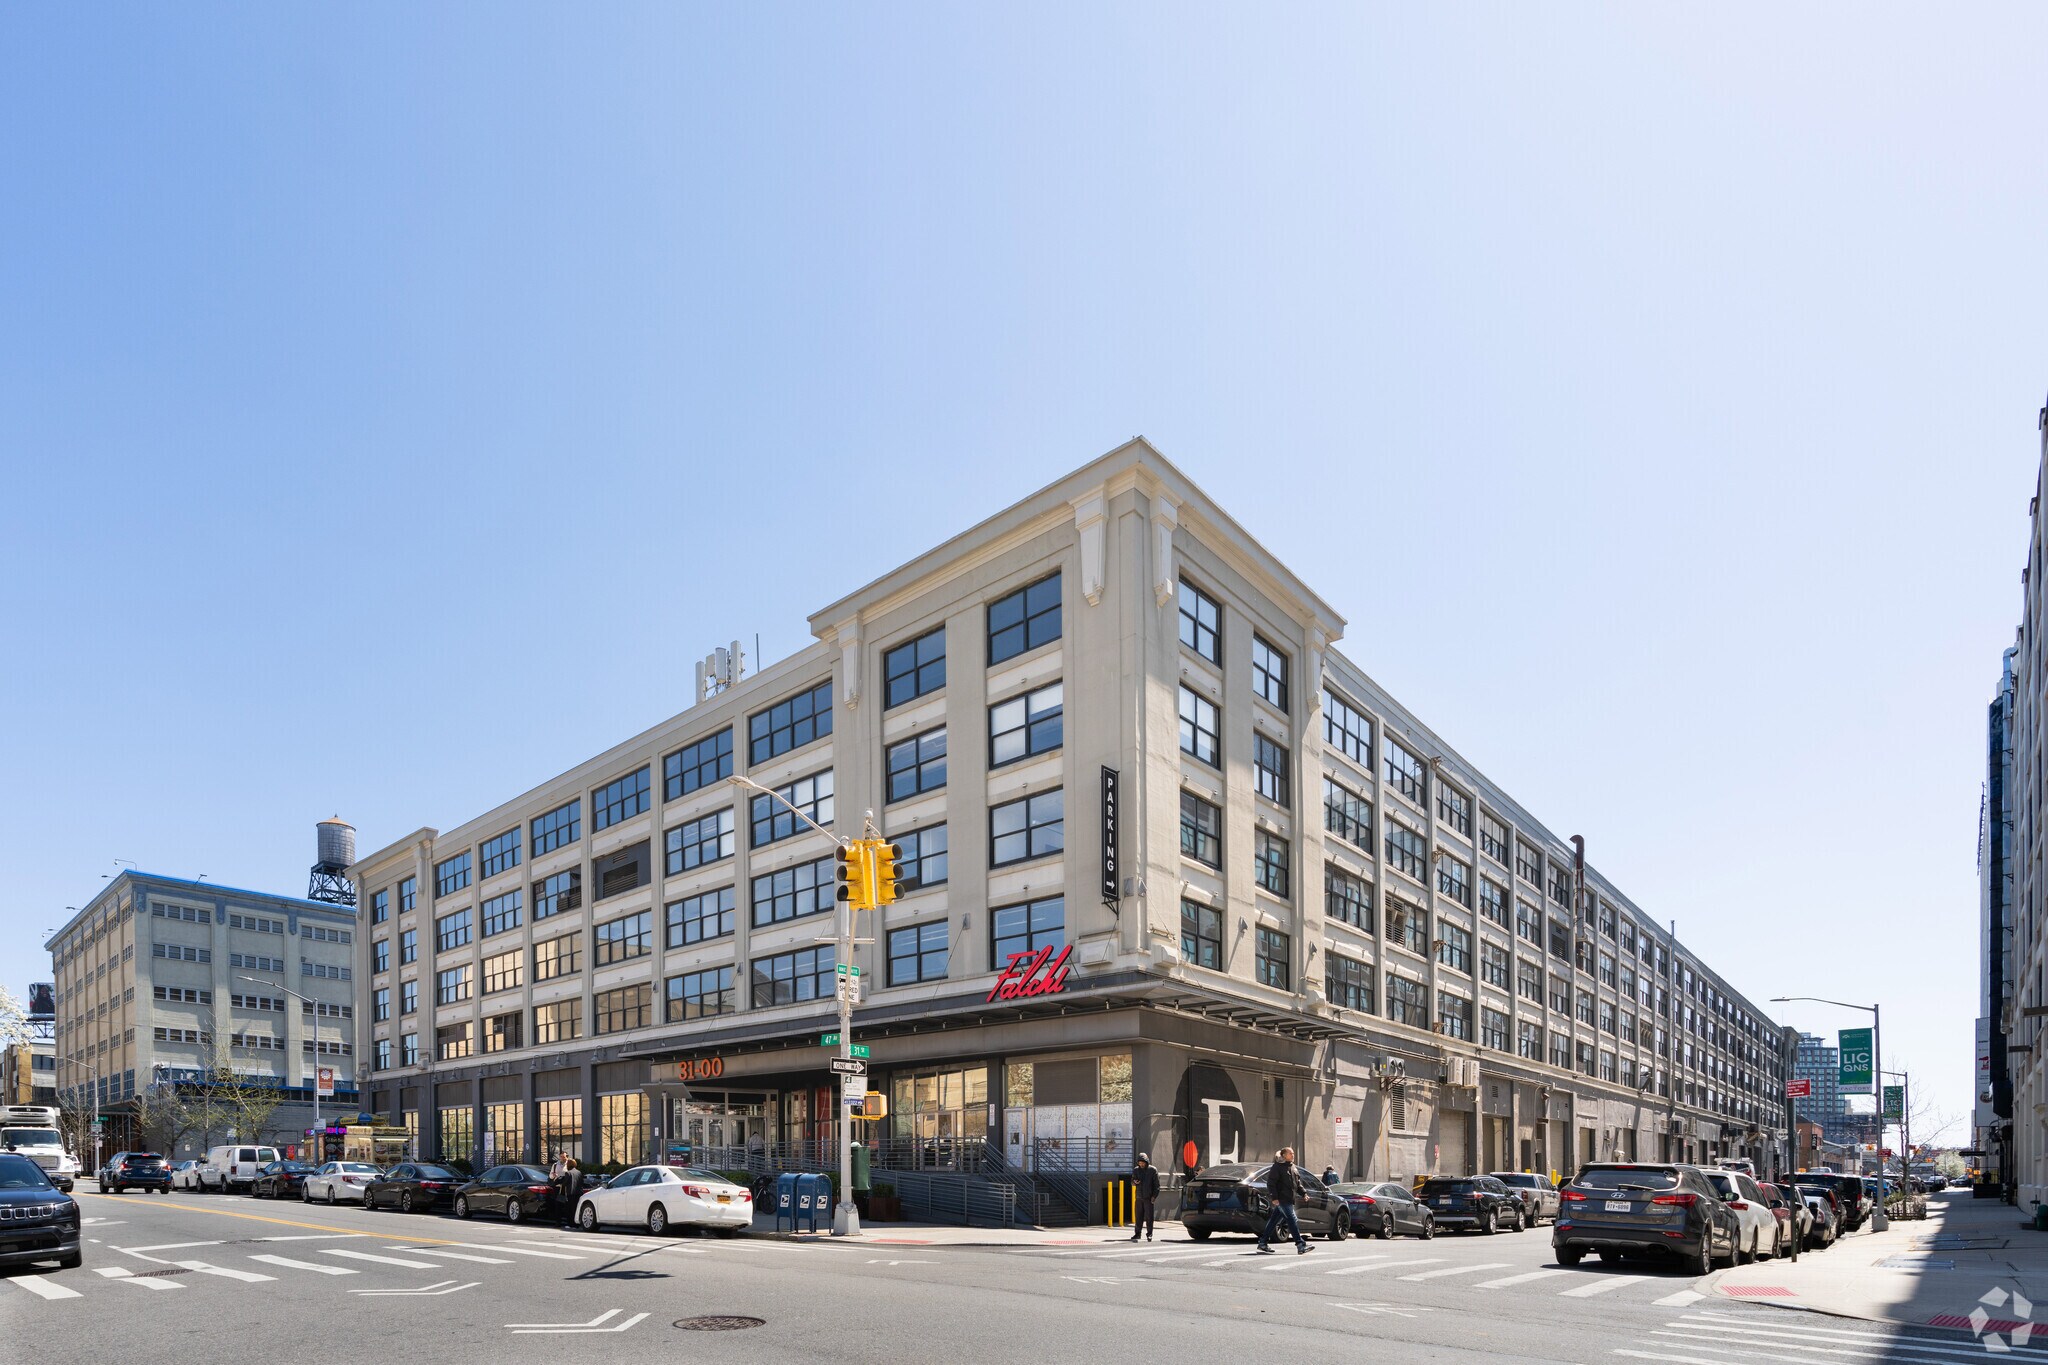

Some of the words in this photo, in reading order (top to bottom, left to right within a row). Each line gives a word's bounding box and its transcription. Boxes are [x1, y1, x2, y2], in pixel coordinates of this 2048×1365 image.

[986, 944, 1073, 1003] Falchi
[839, 985, 858, 994] SHRED
[825, 1035, 832, 1044] 47
[854, 1046, 860, 1055] 31
[1843, 1053, 1870, 1064] LIC
[678, 1056, 723, 1081] 31-00
[835, 1062, 847, 1070] ONE
[1843, 1064, 1869, 1072] QNS
